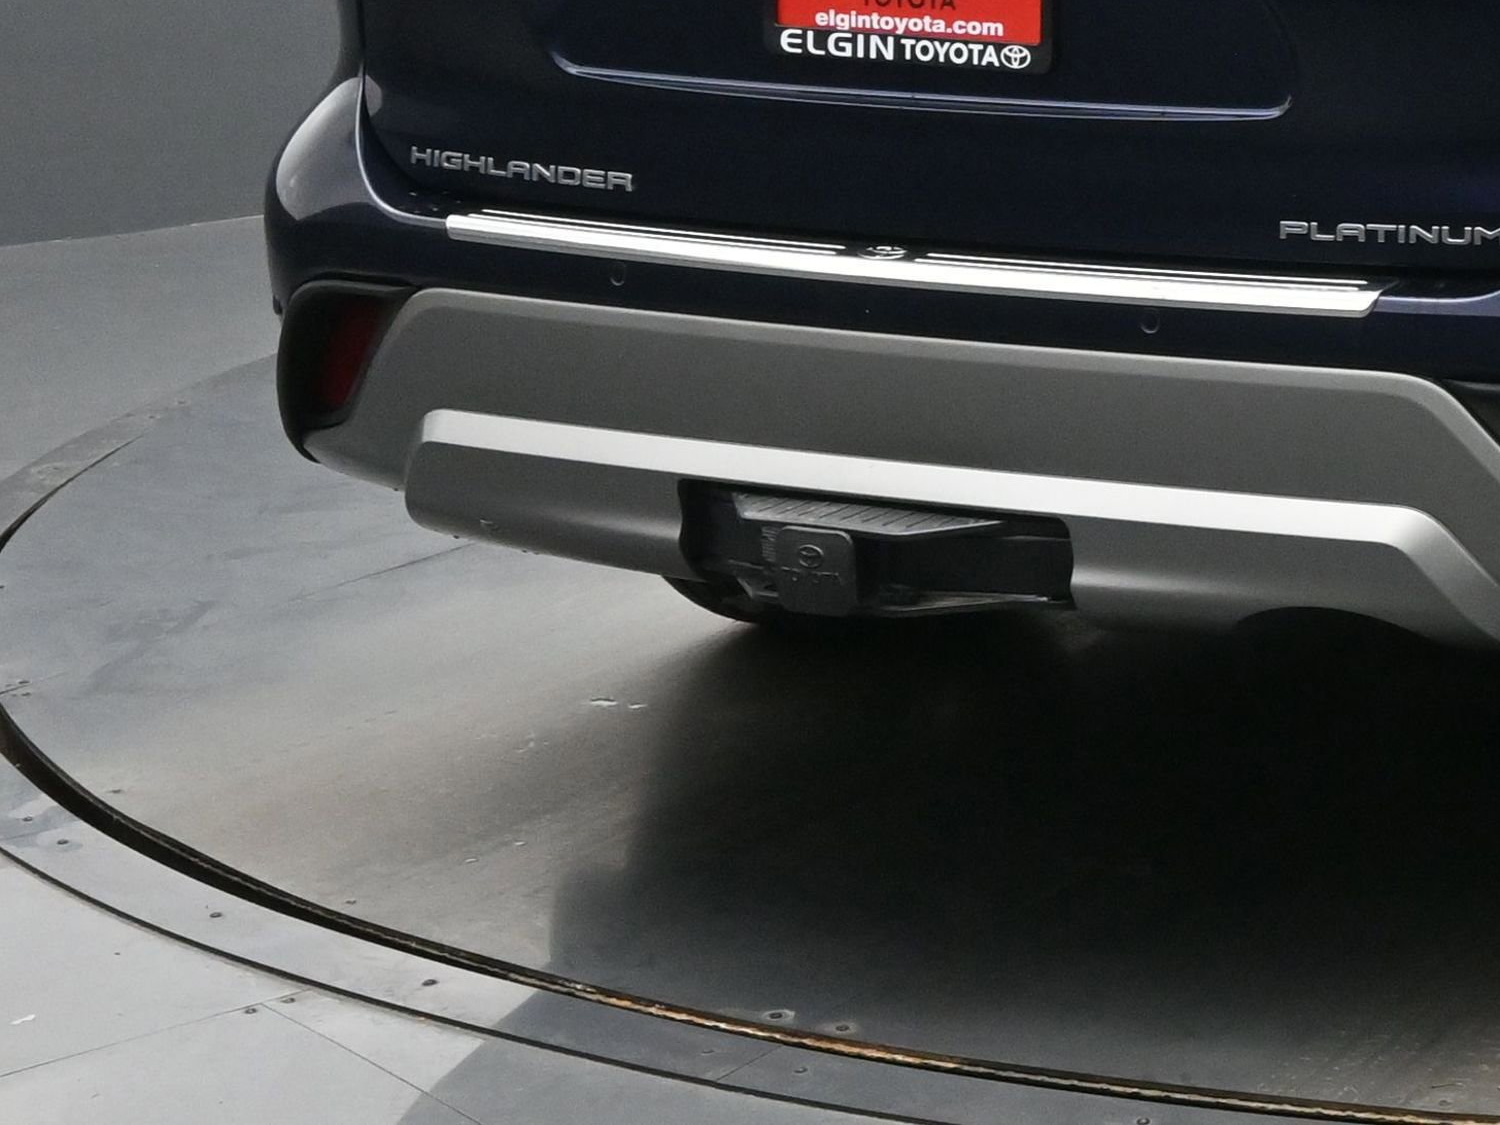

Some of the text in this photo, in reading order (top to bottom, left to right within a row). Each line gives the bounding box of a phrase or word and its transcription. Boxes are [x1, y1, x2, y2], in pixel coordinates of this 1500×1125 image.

[815, 9, 1004, 36] elgintoyota.com
[780, 28, 1000, 67] ELGIN TOYOTA
[410, 145, 634, 192] HIGHLANDER
